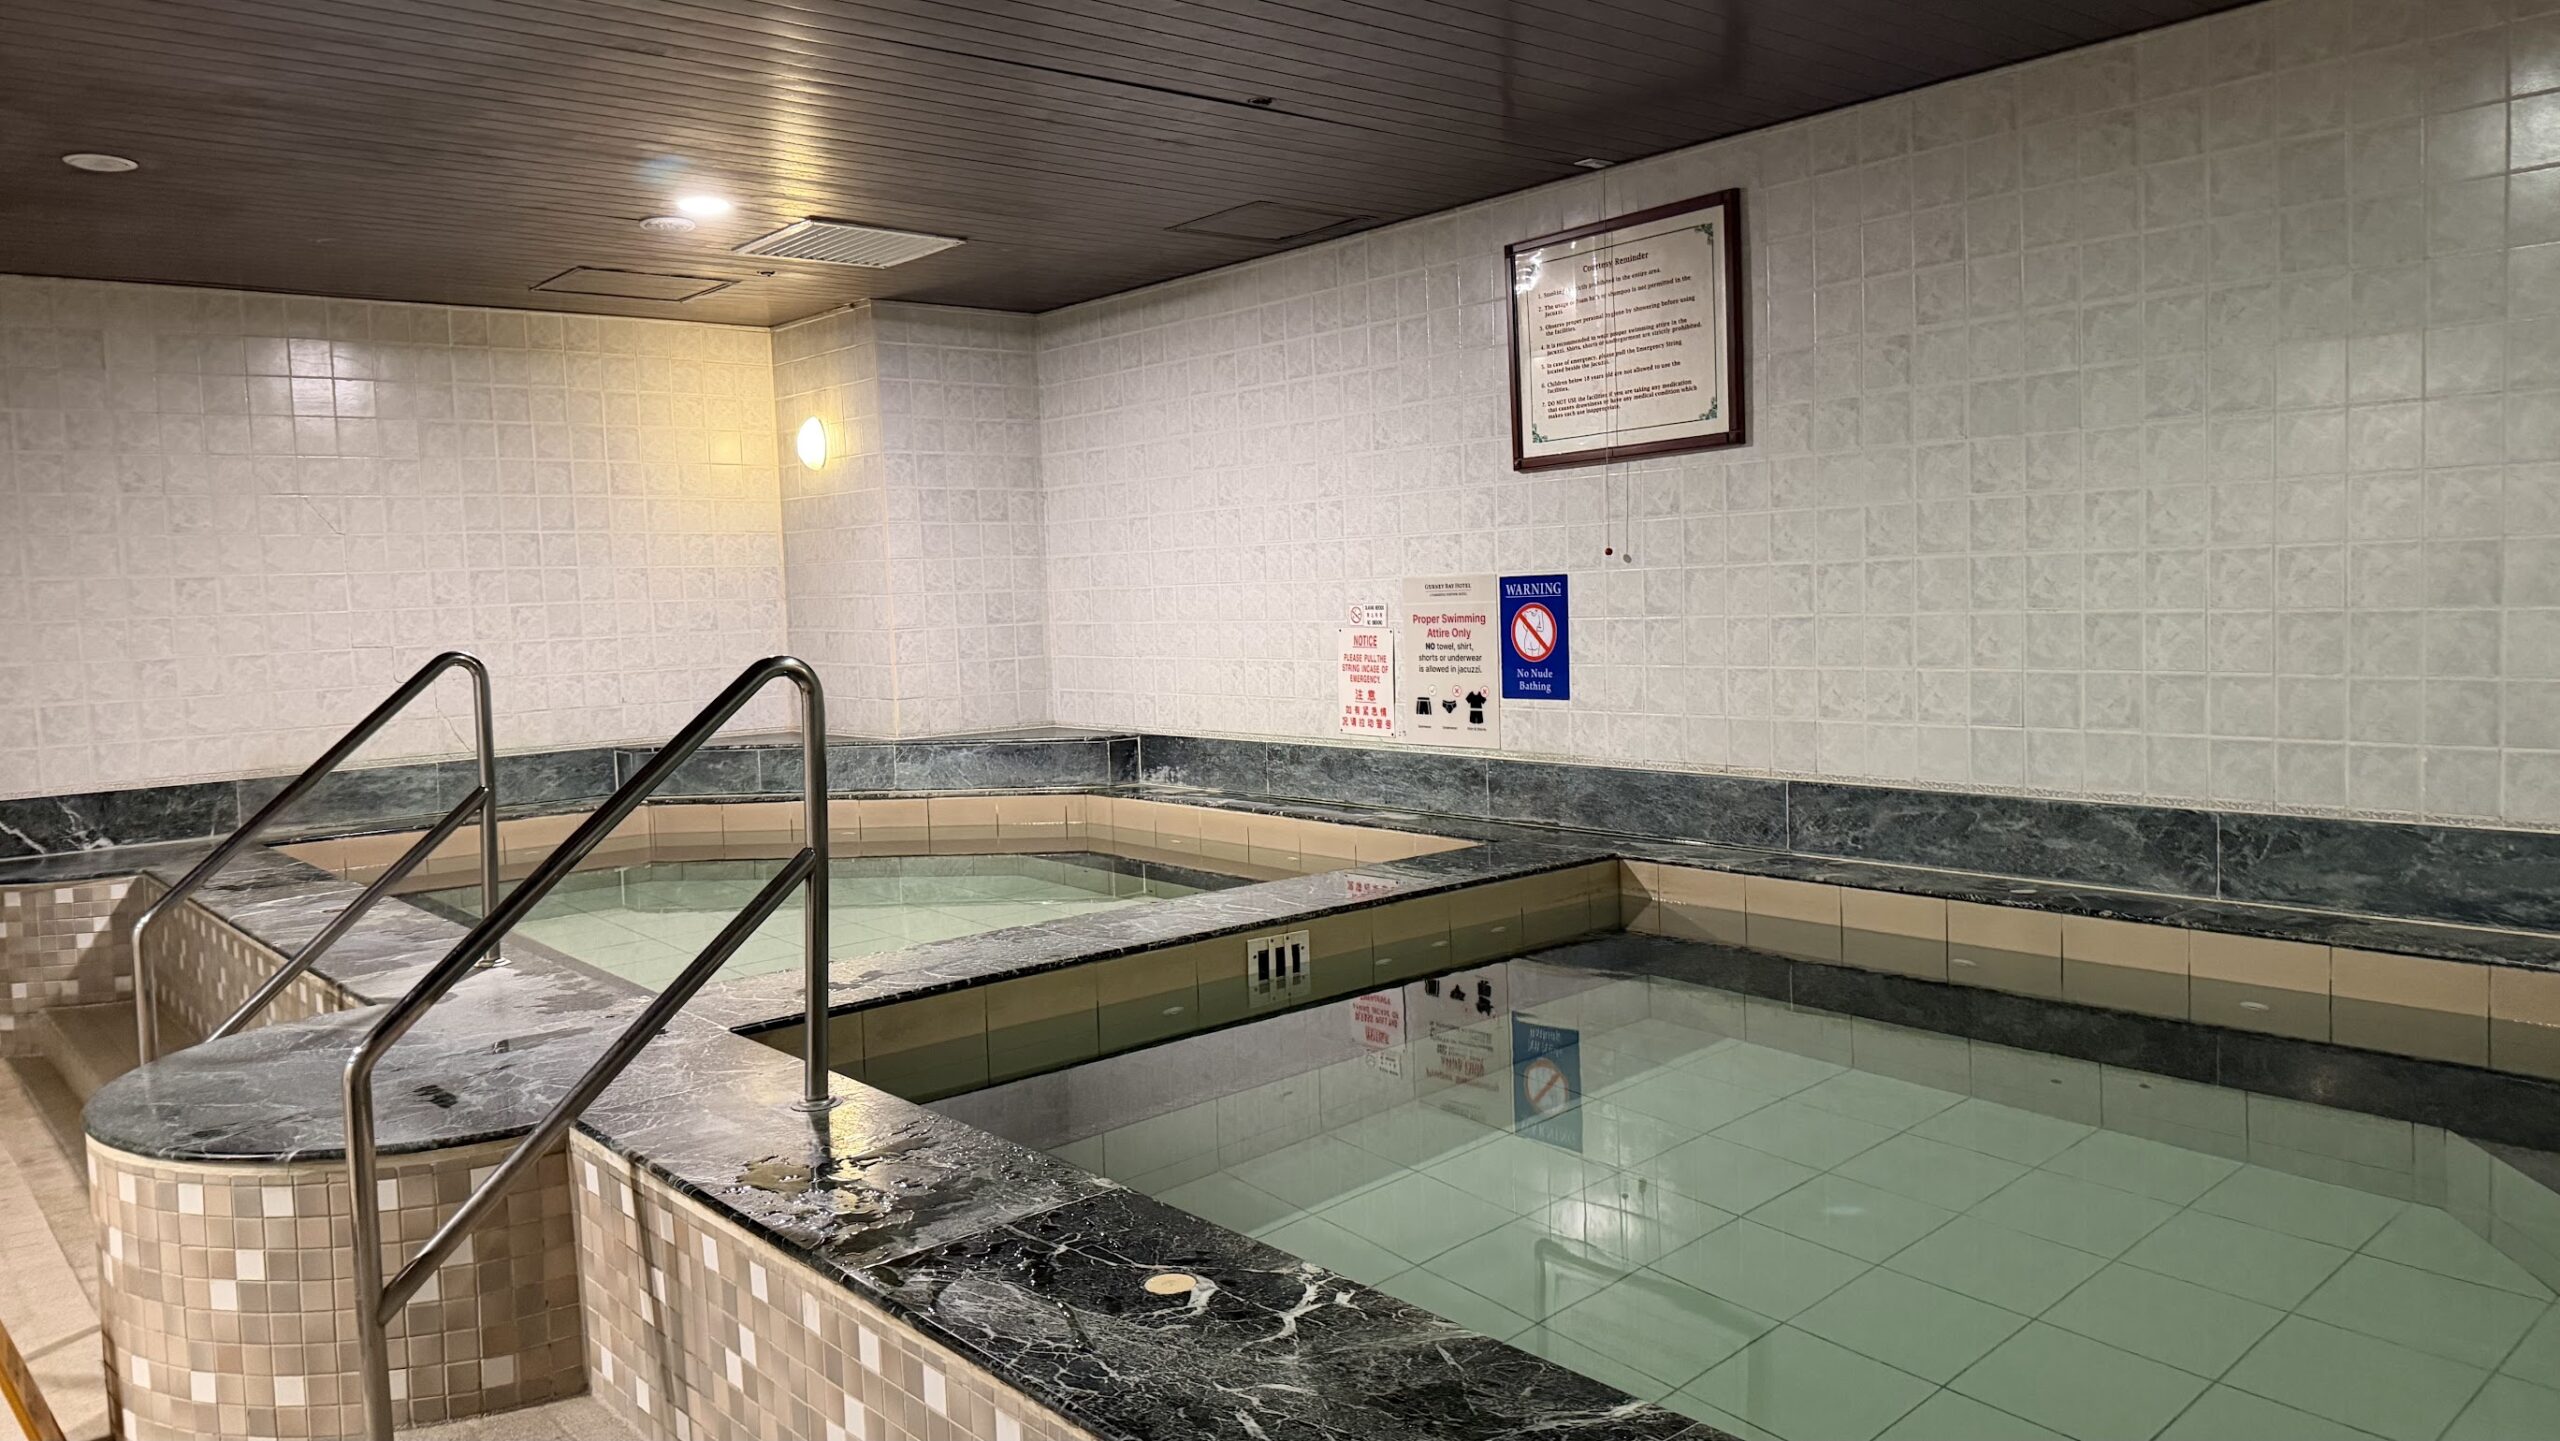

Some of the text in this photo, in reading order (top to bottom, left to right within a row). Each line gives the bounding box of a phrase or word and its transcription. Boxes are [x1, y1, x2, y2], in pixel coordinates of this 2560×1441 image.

[1615, 252, 1648, 265] Reminder
[1647, 278, 1673, 289] permitted
[1583, 314, 1603, 323] personal
[1633, 303, 1660, 312] showering
[1557, 336, 1589, 348] recommended
[1629, 325, 1654, 333] swimming
[1636, 344, 1664, 352] Emergency
[1634, 364, 1653, 373] allowed
[1662, 380, 1691, 388] medication
[1506, 582, 1562, 596] WARNING
[1412, 613, 1486, 625] Proper Swimming
[1427, 628, 1471, 639] Attire Only
[1354, 635, 1377, 646] NOTICE
[1437, 643, 1455, 651] towel,
[1457, 642, 1474, 651] shirt,
[1344, 654, 1362, 662] PLEASE
[1342, 664, 1360, 672] STRING
[1457, 665, 1482, 674] jacuzzi.
[1517, 668, 1553, 678] No Nude
[1520, 681, 1552, 694] Bathing
[1355, 689, 1376, 701] 注意
